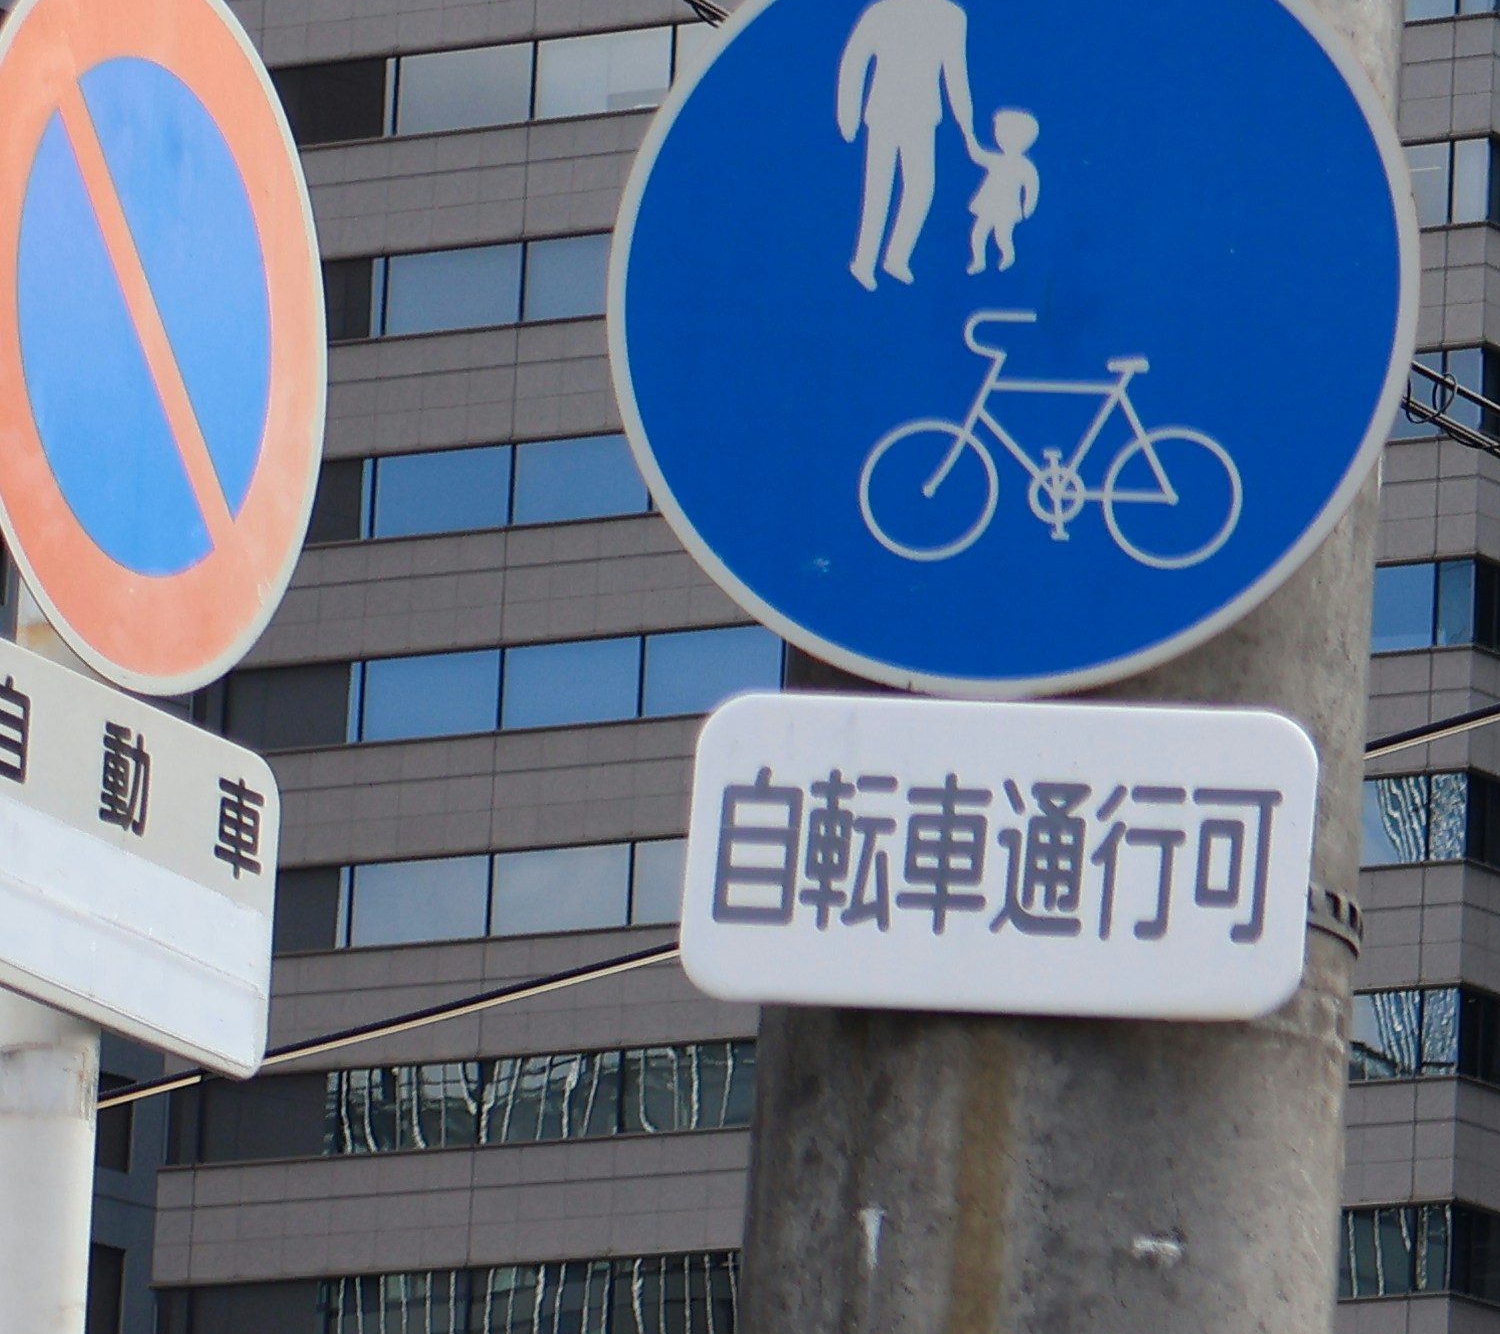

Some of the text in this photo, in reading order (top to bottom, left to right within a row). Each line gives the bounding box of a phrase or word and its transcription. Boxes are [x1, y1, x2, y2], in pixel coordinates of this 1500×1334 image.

[712, 766, 1283, 944] 自転車通行可
